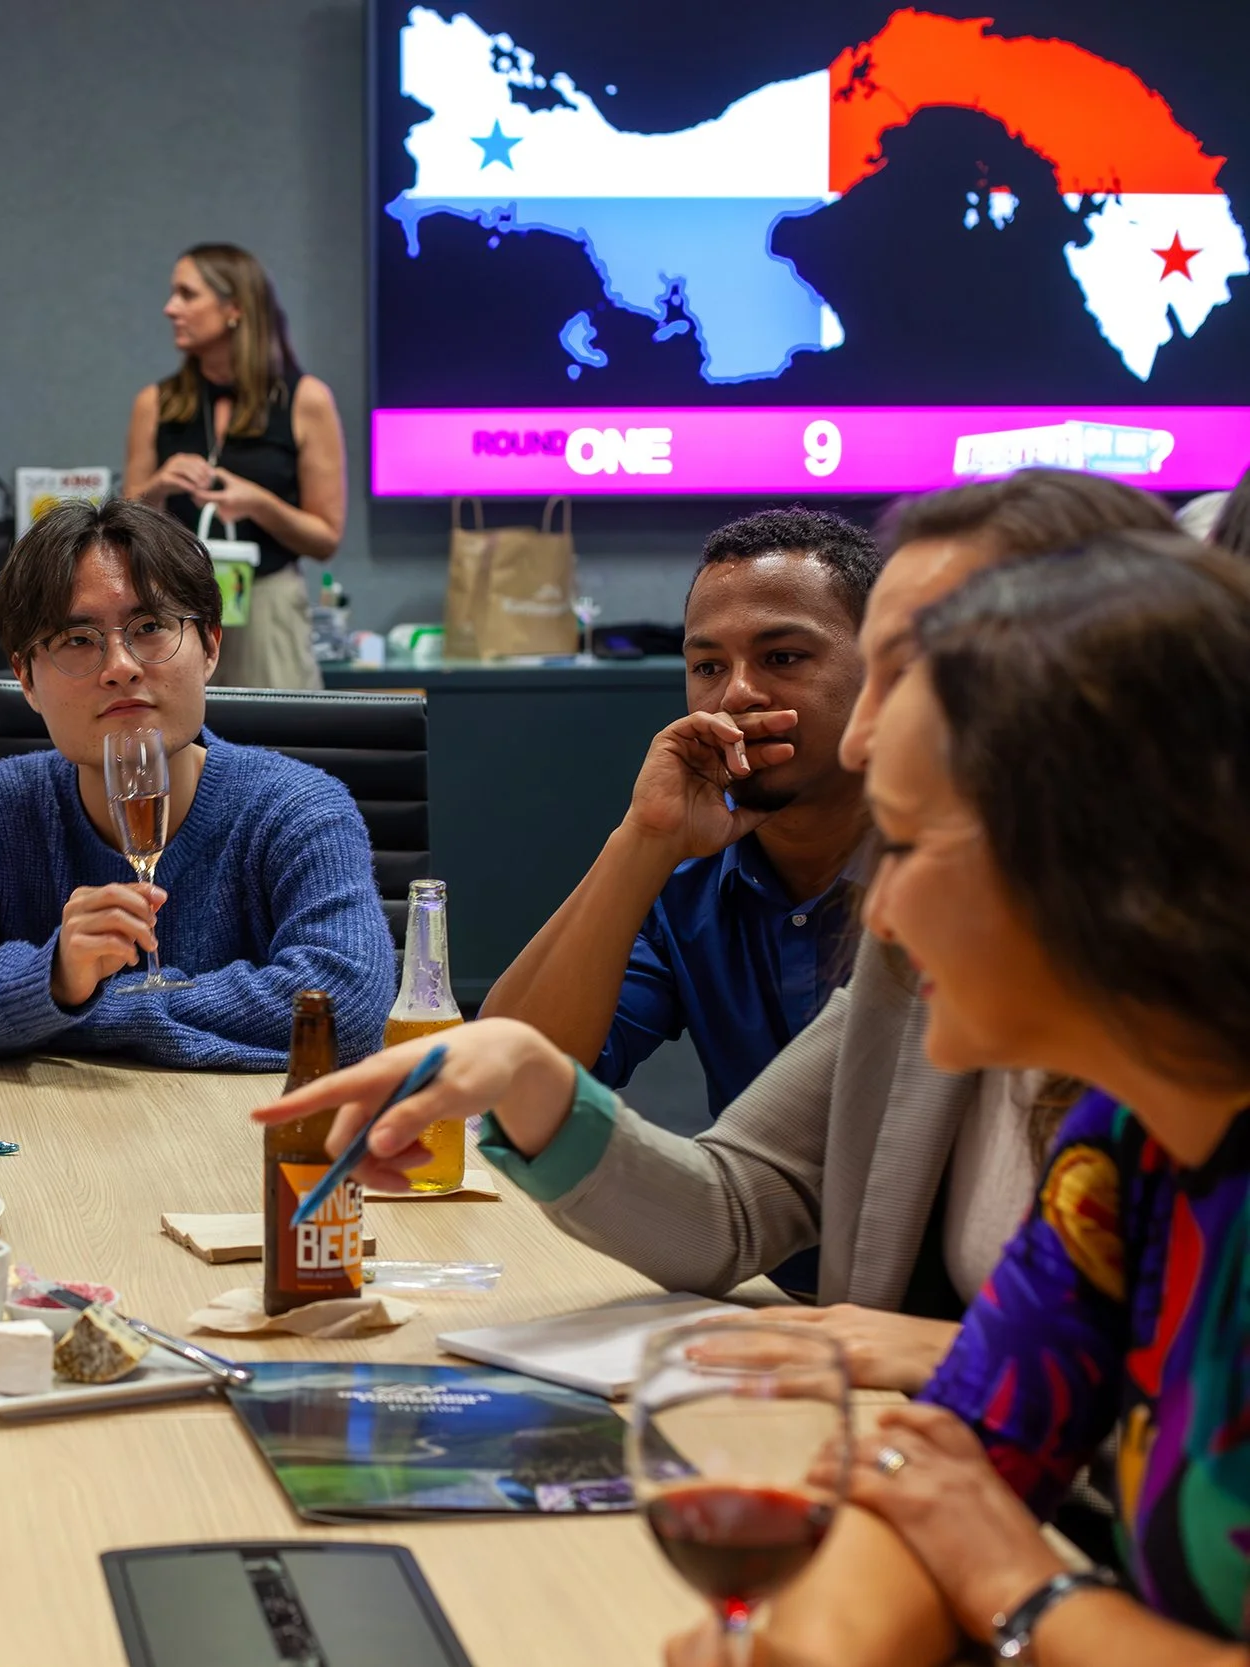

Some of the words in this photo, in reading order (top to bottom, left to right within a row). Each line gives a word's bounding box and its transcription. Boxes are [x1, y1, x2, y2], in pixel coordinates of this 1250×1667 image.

[472, 429, 569, 456] ROUND
[565, 427, 673, 475] ONE
[803, 419, 842, 477] 9
[297, 1222, 363, 1269] BEE
